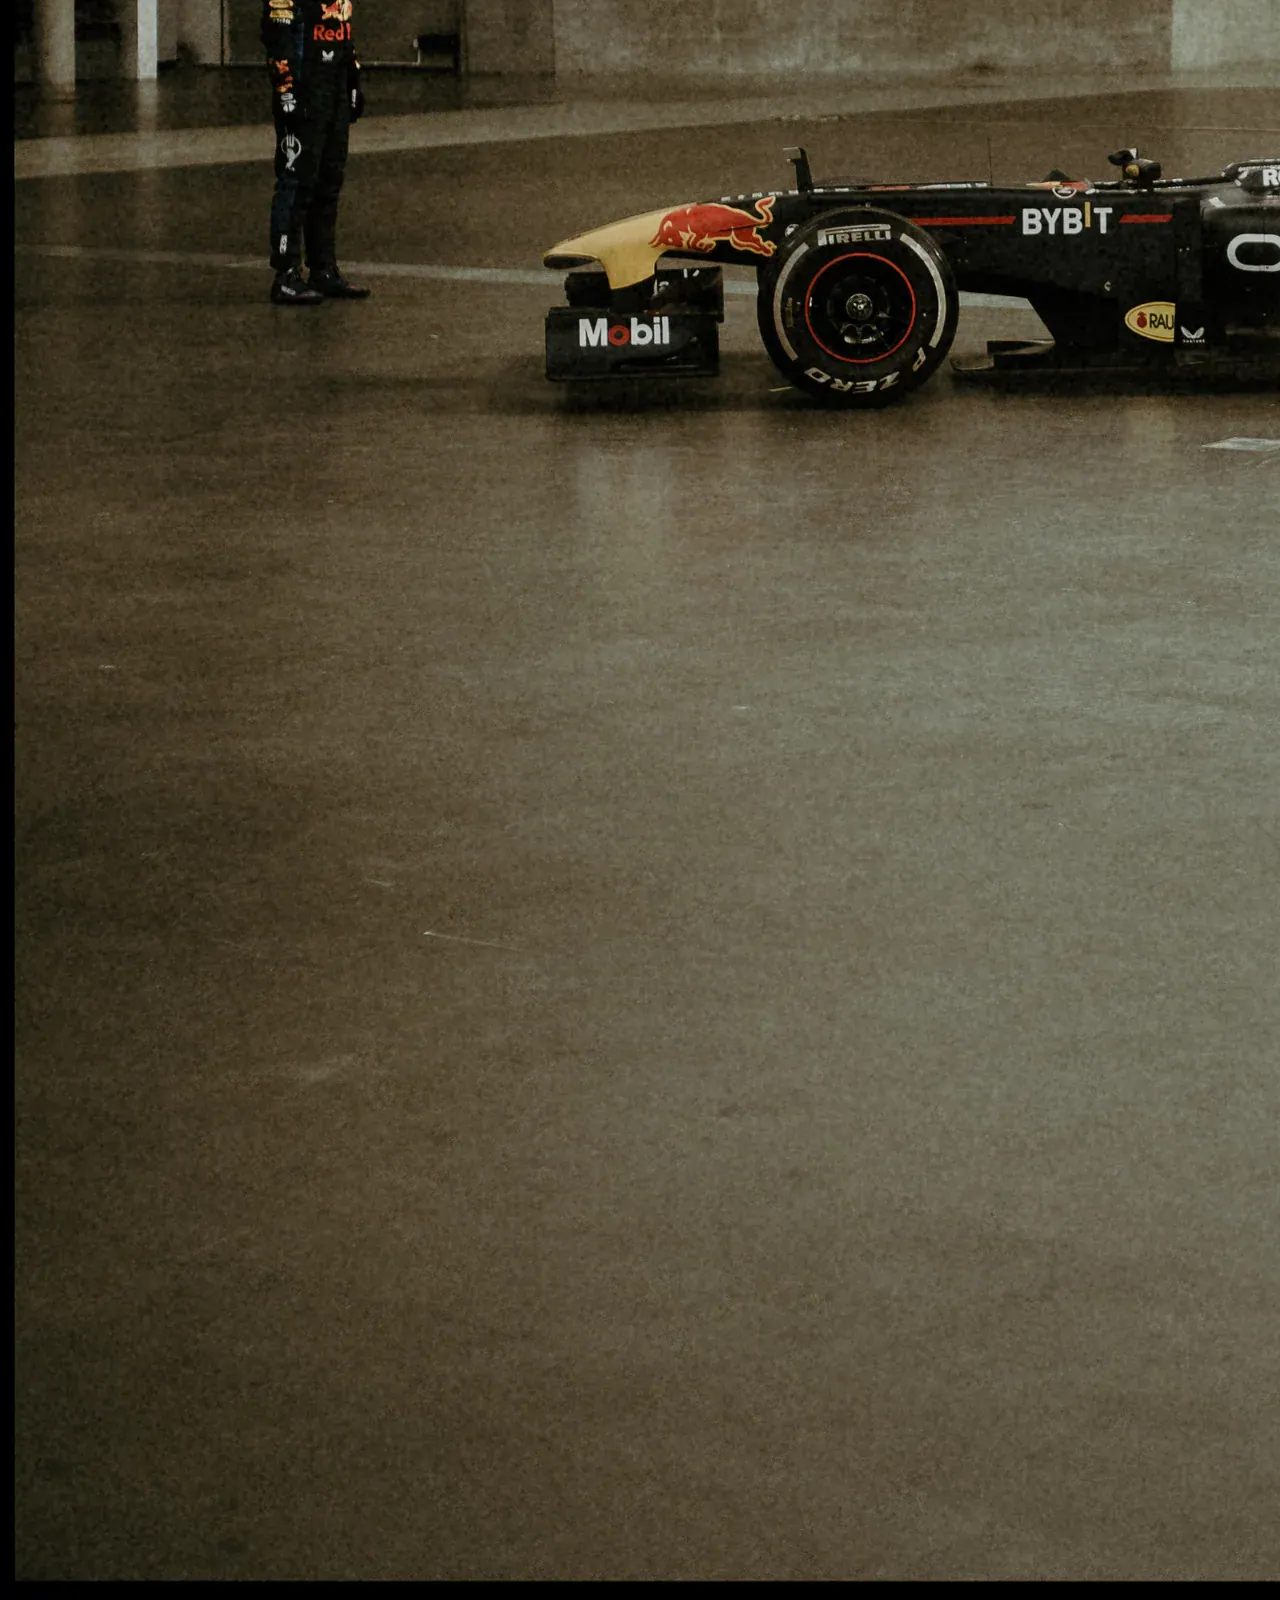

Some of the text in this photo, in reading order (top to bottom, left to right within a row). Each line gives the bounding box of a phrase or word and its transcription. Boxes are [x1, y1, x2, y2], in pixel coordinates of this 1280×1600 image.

[1022, 201, 1113, 235] BYBIT
[817, 224, 892, 247] PIRELLI
[579, 316, 670, 347] Mobil
[804, 347, 926, 394] P ZERO
